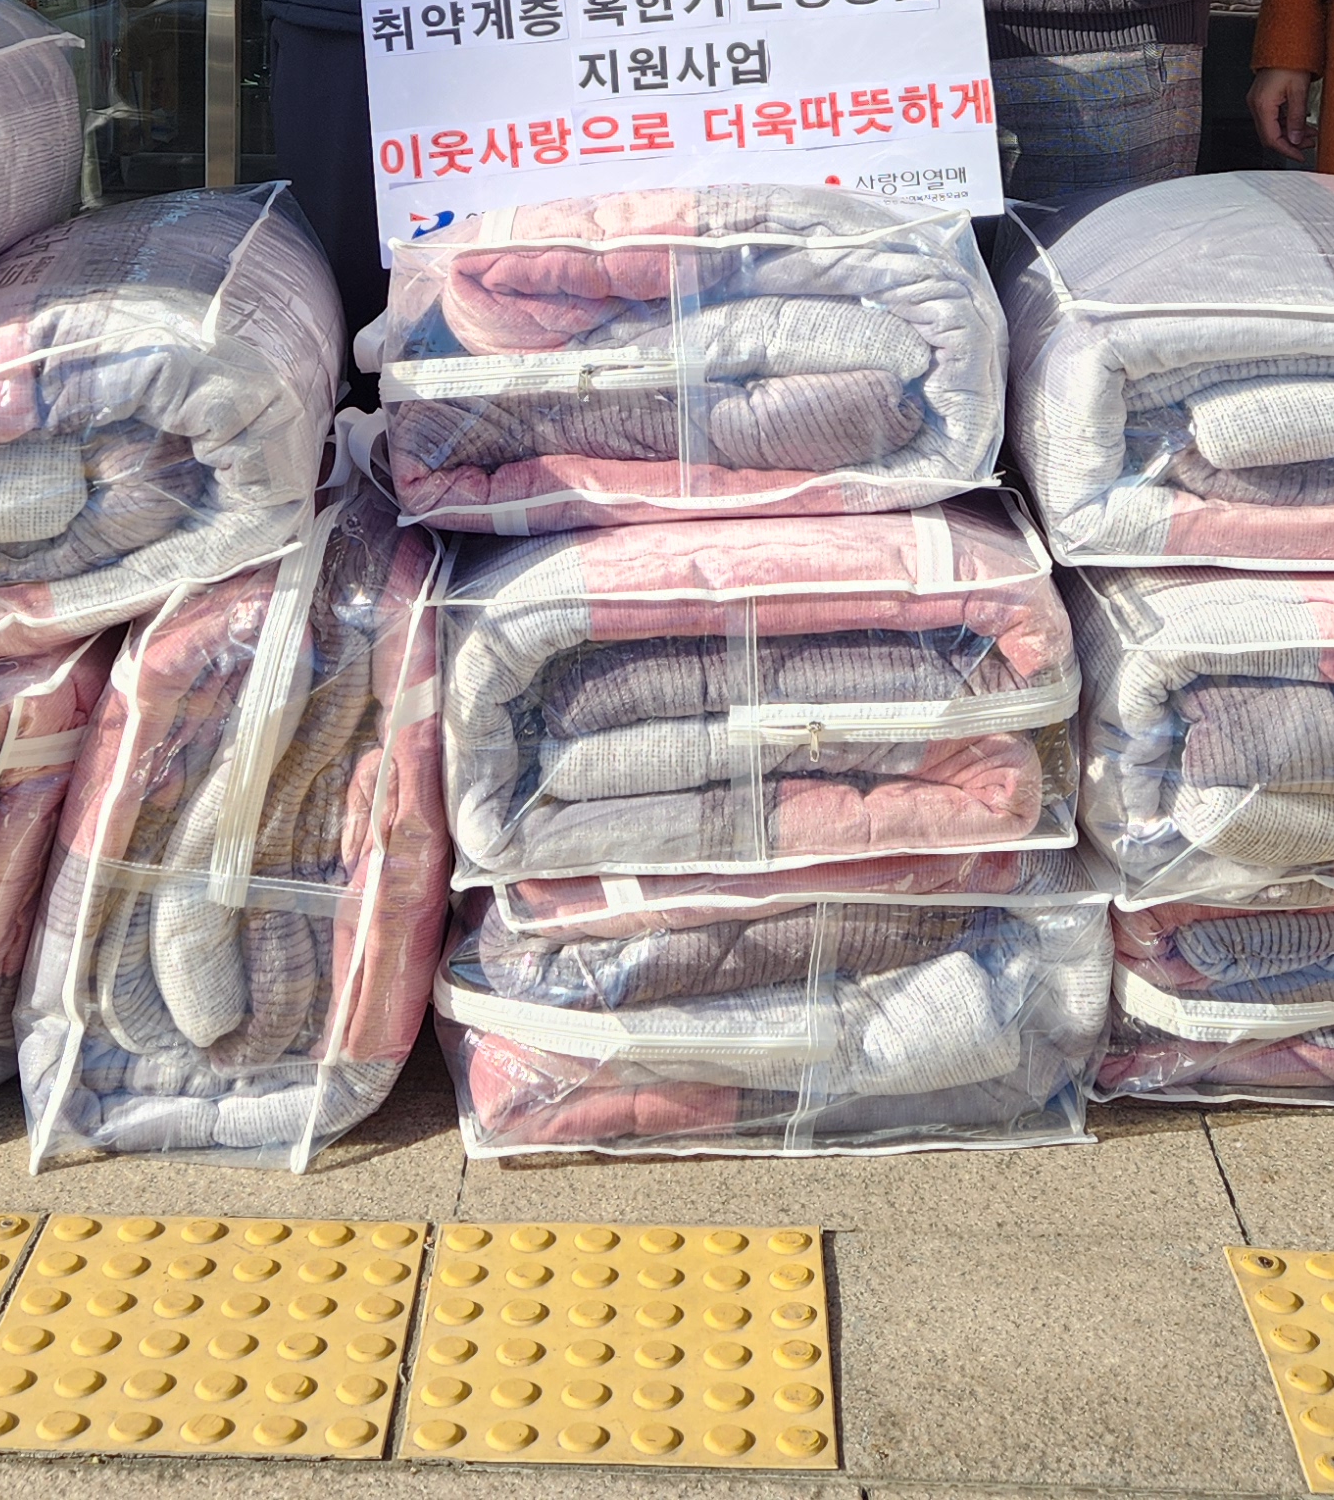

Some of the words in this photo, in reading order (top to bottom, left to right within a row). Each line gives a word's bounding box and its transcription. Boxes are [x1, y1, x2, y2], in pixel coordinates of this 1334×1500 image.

[577, 38, 770, 94] 지원사업
[379, 108, 675, 180] 이웃사랑으로
[703, 77, 995, 150] 더욱따뜻하게
[855, 166, 967, 196] 사랑의열매
